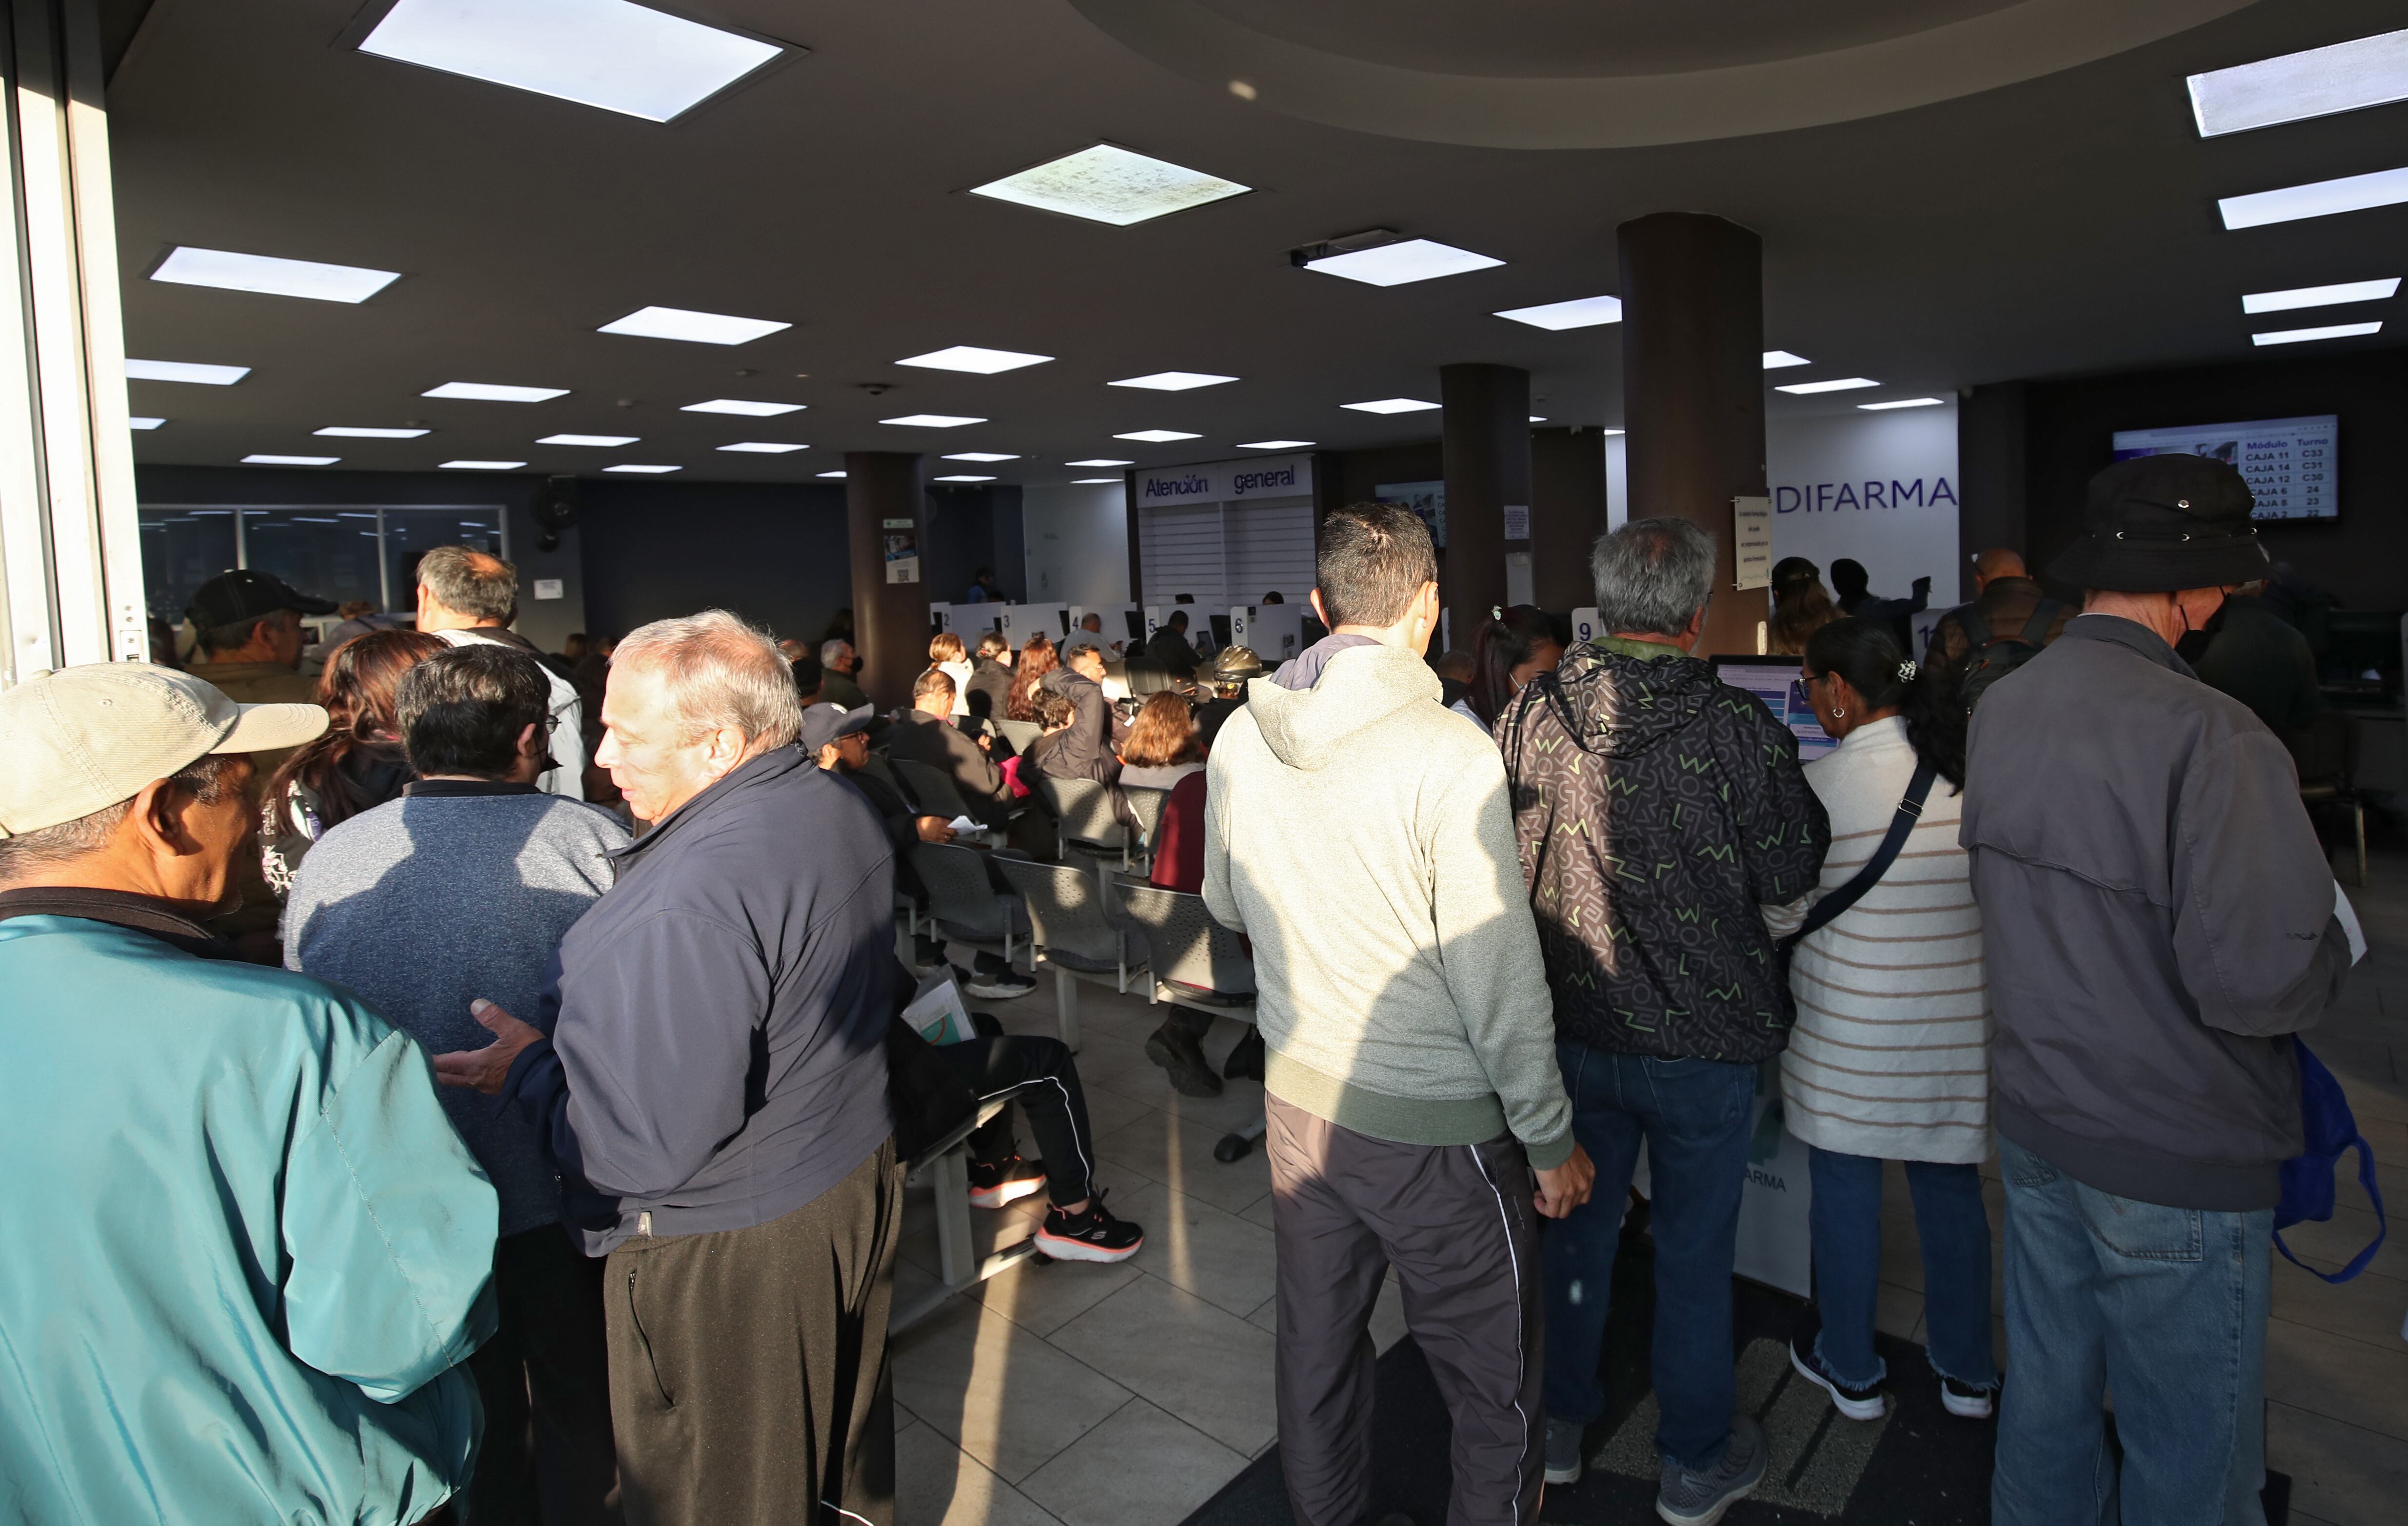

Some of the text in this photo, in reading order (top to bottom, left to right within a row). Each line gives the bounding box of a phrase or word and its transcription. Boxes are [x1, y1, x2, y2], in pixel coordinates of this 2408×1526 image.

[2247, 441, 2288, 450] Módulo
[2246, 453, 2274, 461] CAJA
[2302, 449, 2324, 457] C33
[2246, 465, 2274, 473] CAJA
[1146, 465, 1295, 497] Atención general
[2246, 476, 2274, 485] CAJA
[1767, 477, 1958, 514] DIFARMA
[2281, 510, 2288, 518] 2
[944, 614, 950, 627] 2
[1003, 615, 1010, 628] 3
[1073, 616, 1079, 629] 4
[1148, 618, 1155, 633] 5
[1235, 618, 1243, 634] 6
[1579, 622, 1591, 641] 9
[1745, 1168, 1787, 1192] ARMA
